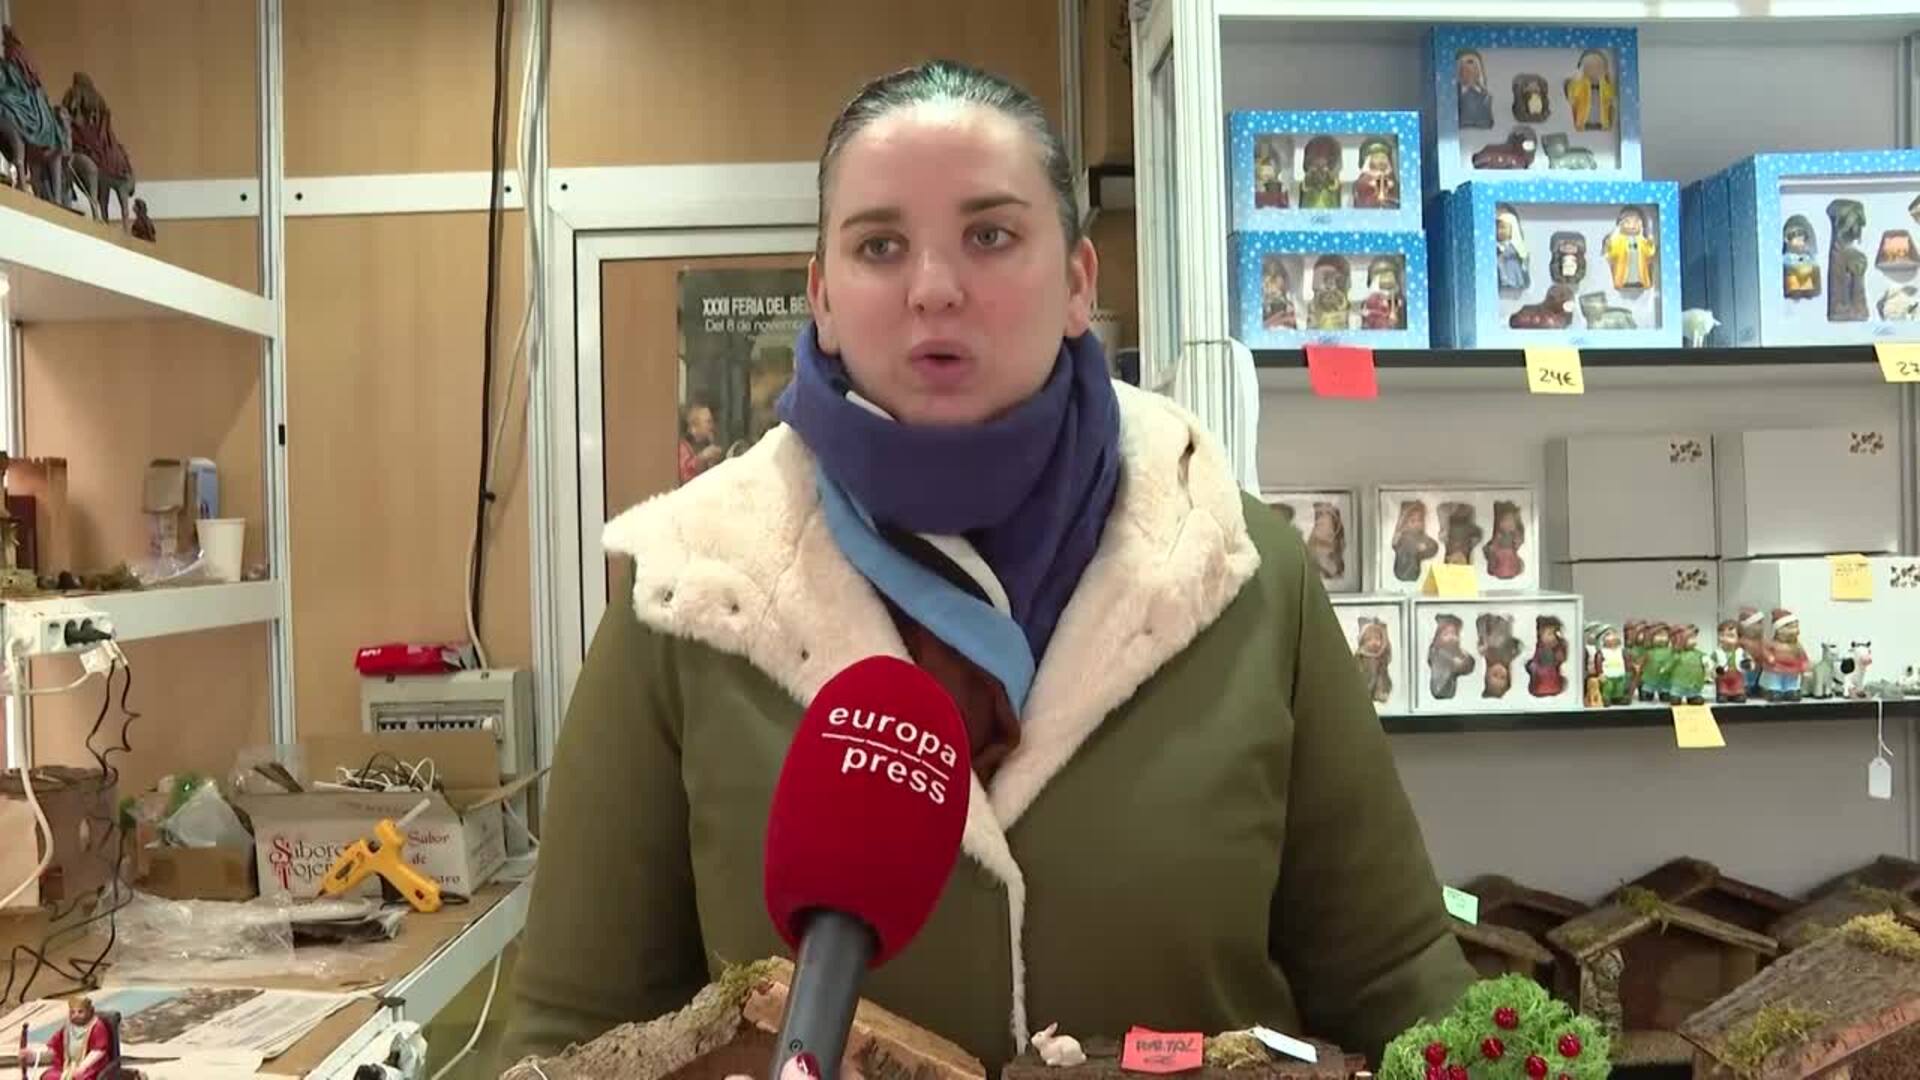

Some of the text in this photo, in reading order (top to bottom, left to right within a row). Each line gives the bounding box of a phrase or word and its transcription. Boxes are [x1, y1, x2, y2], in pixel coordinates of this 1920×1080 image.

[731, 296, 764, 315] FERIA
[766, 296, 788, 314] DEL
[705, 318, 725, 332] Del
[736, 319, 752, 332] de
[1539, 366, 1576, 387] 24€
[828, 707, 957, 768] europa
[841, 747, 946, 804] press
